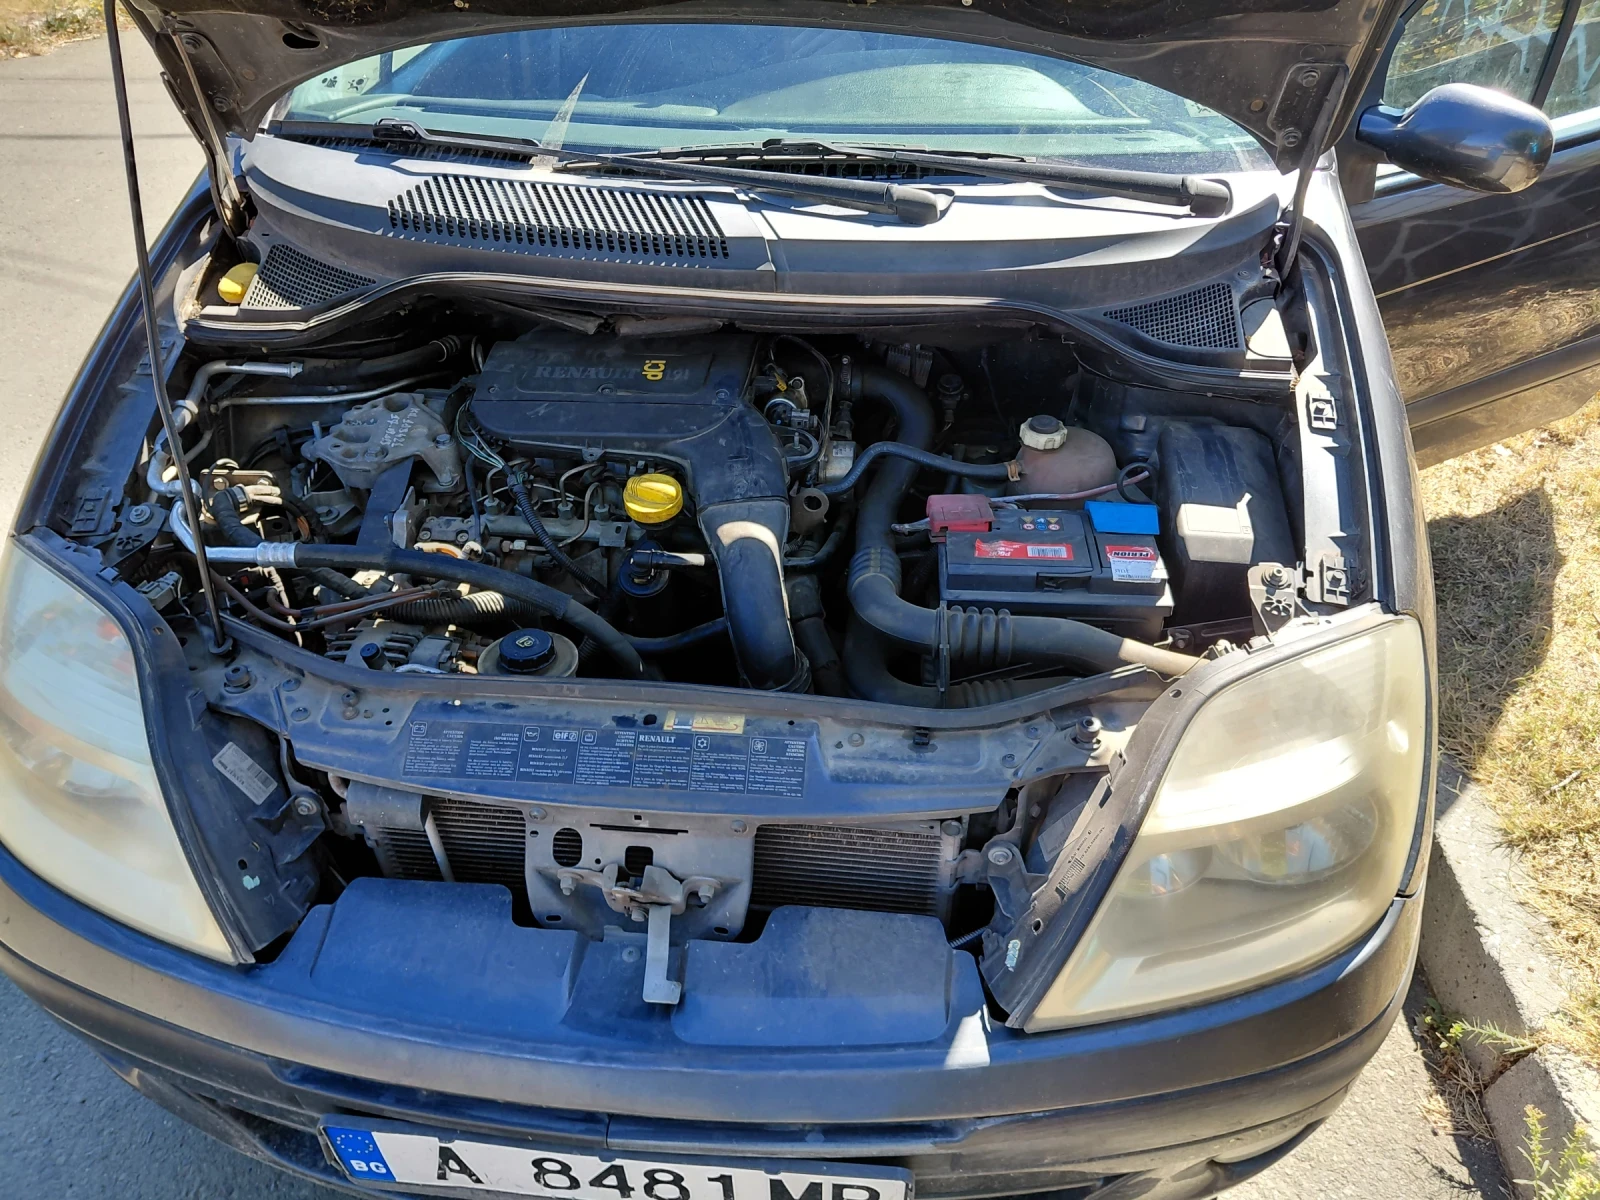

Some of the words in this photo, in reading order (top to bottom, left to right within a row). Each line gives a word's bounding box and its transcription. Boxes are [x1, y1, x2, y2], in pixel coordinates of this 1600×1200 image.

[533, 366, 640, 379] RENAULT
[639, 734, 676, 743] RENAULT
[350, 1160, 387, 1174] BG
[437, 1146, 485, 1184] A
[531, 1157, 735, 1200] 8481
